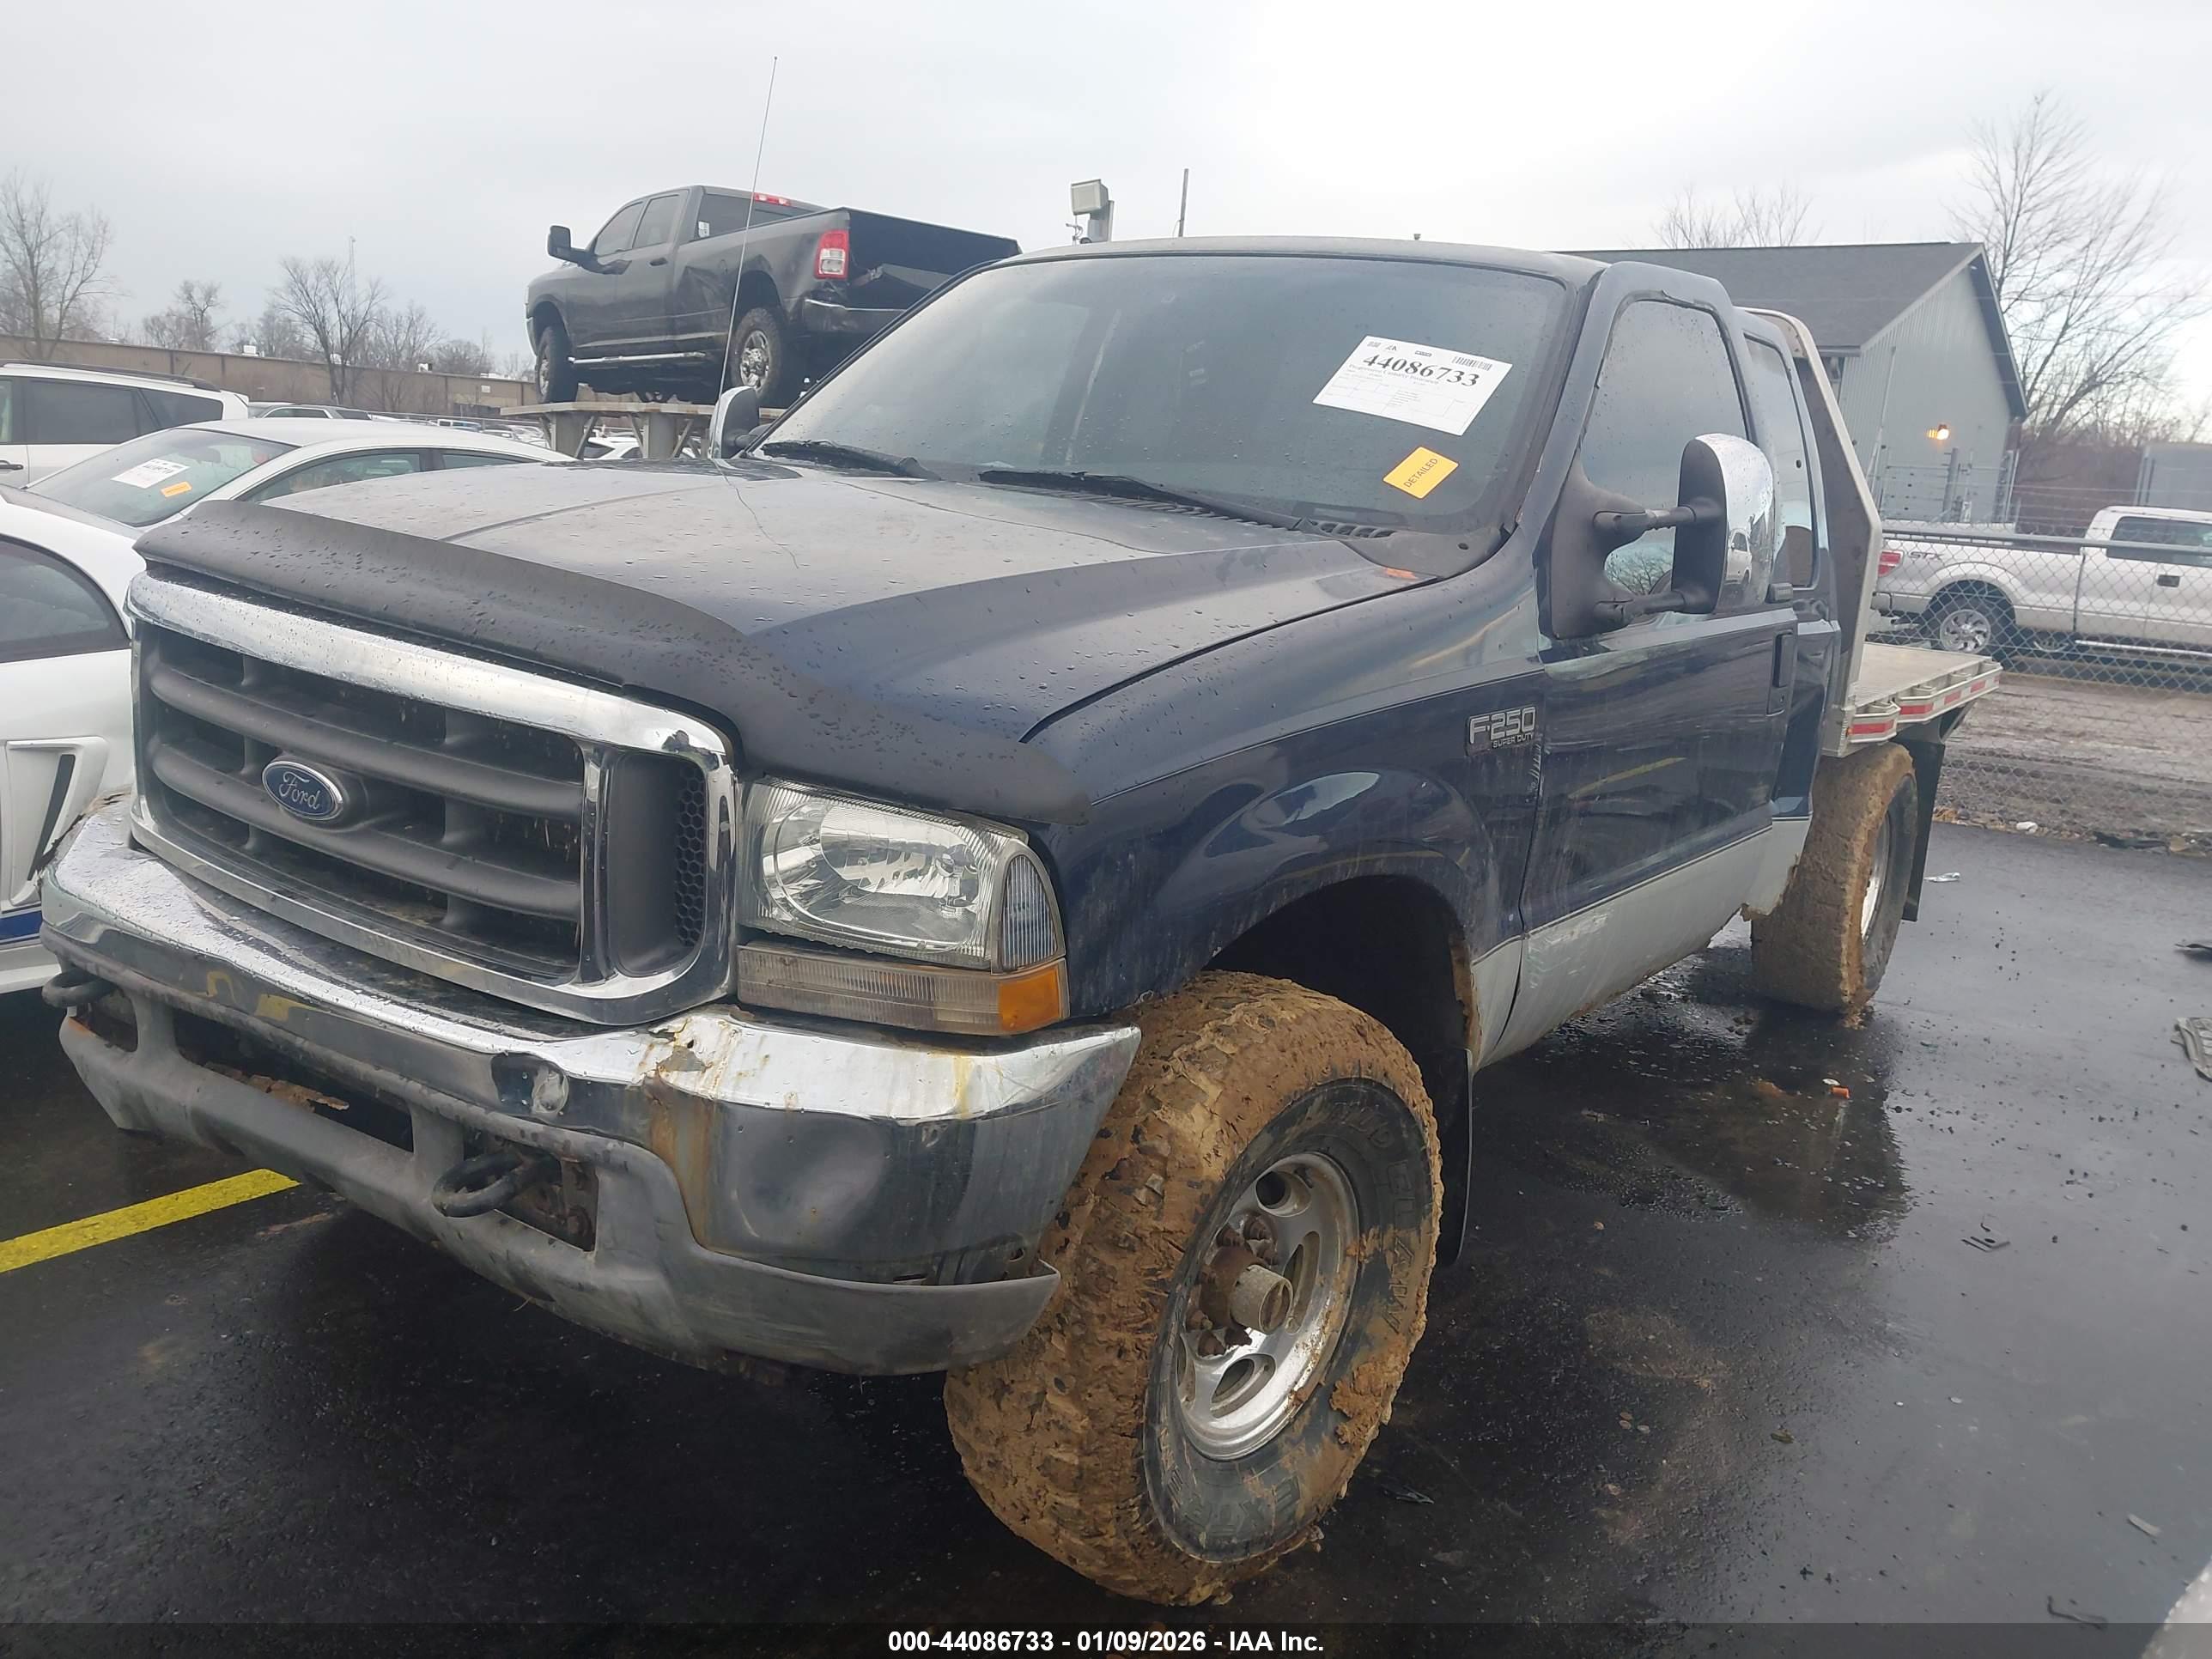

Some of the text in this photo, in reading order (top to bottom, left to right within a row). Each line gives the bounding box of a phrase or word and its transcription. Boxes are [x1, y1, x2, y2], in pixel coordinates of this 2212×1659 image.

[1363, 353, 1480, 387] 44086733
[1403, 458, 1438, 488] DETAILED
[1907, 550, 1945, 561] STX
[1492, 732, 1534, 748] SUPER DUTY
[278, 770, 322, 811] Ford
